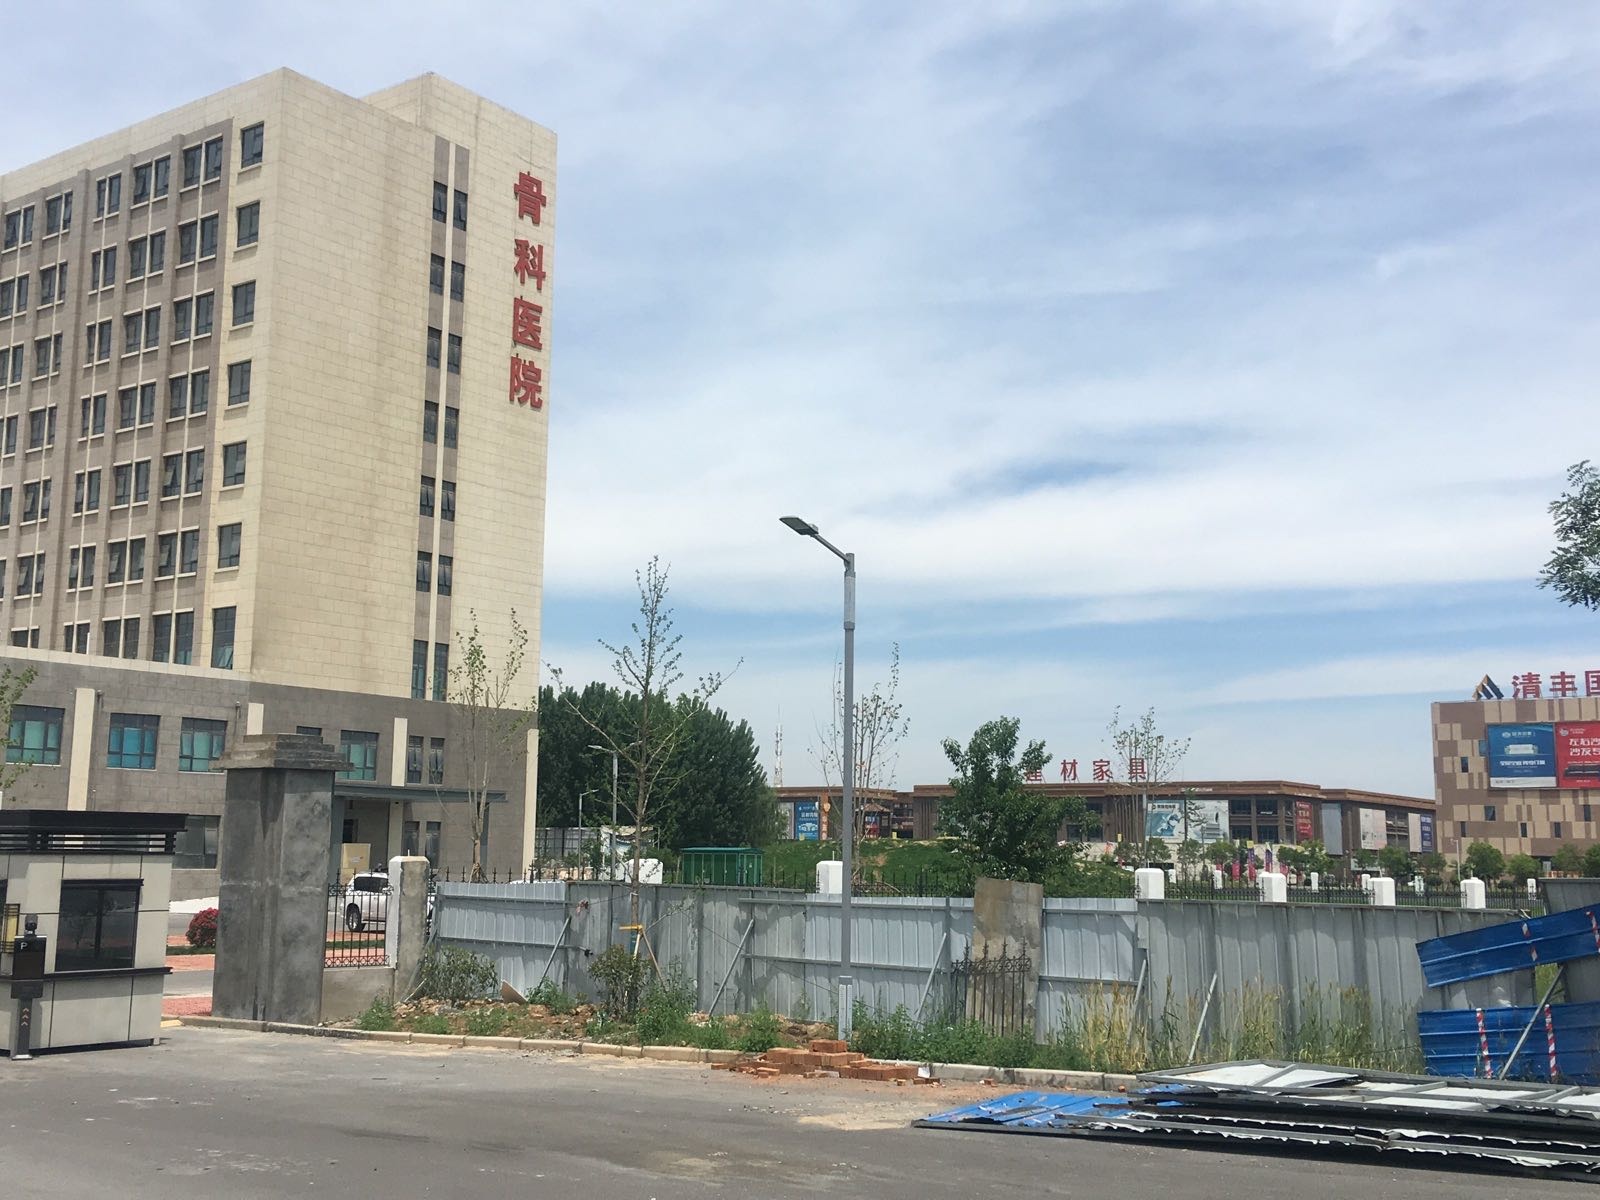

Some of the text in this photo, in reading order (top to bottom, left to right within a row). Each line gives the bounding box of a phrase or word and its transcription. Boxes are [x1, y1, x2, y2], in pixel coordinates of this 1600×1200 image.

[509, 171, 547, 409] 骨科医院
[20, 942, 28, 950] P
